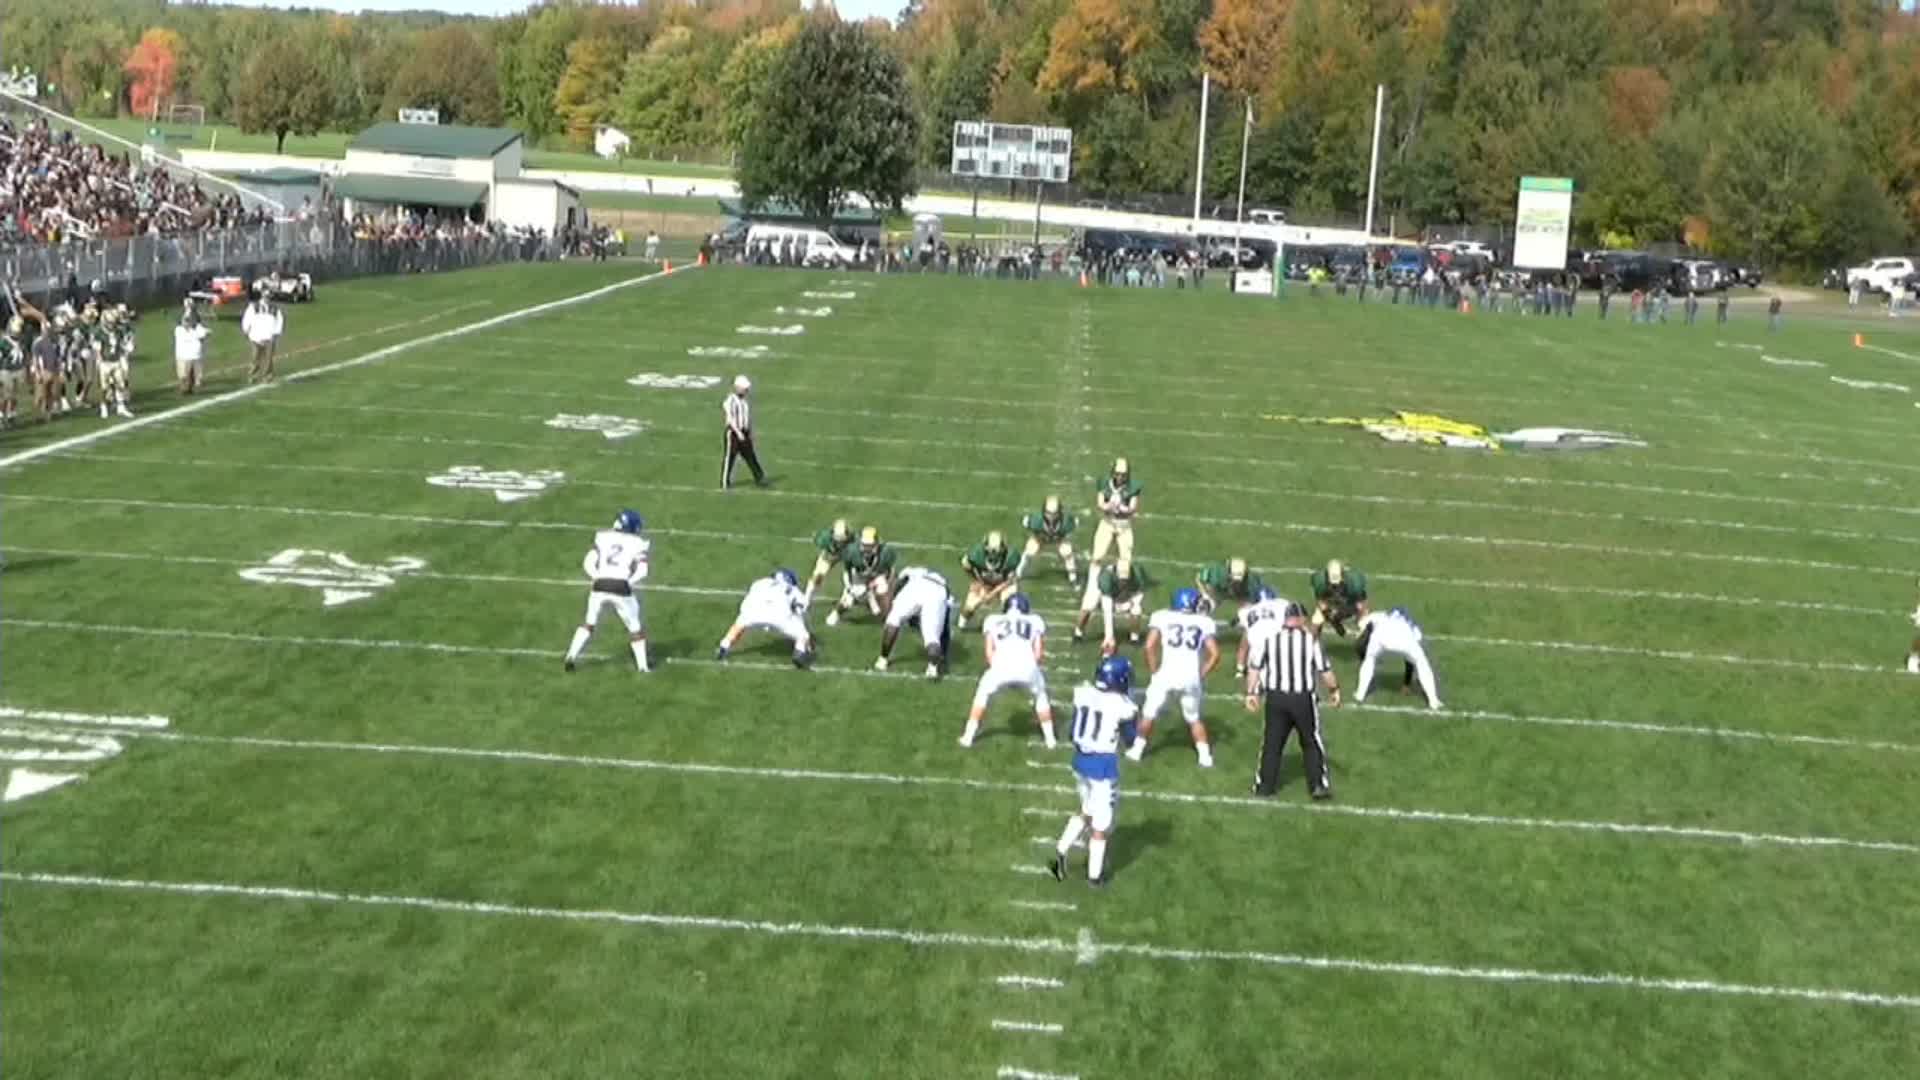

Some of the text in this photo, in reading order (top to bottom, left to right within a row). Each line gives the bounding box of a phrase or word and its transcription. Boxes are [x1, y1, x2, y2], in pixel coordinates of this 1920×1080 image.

[606, 543, 623, 566] 2
[1167, 623, 1203, 650] 33
[1078, 704, 1104, 741] 11
